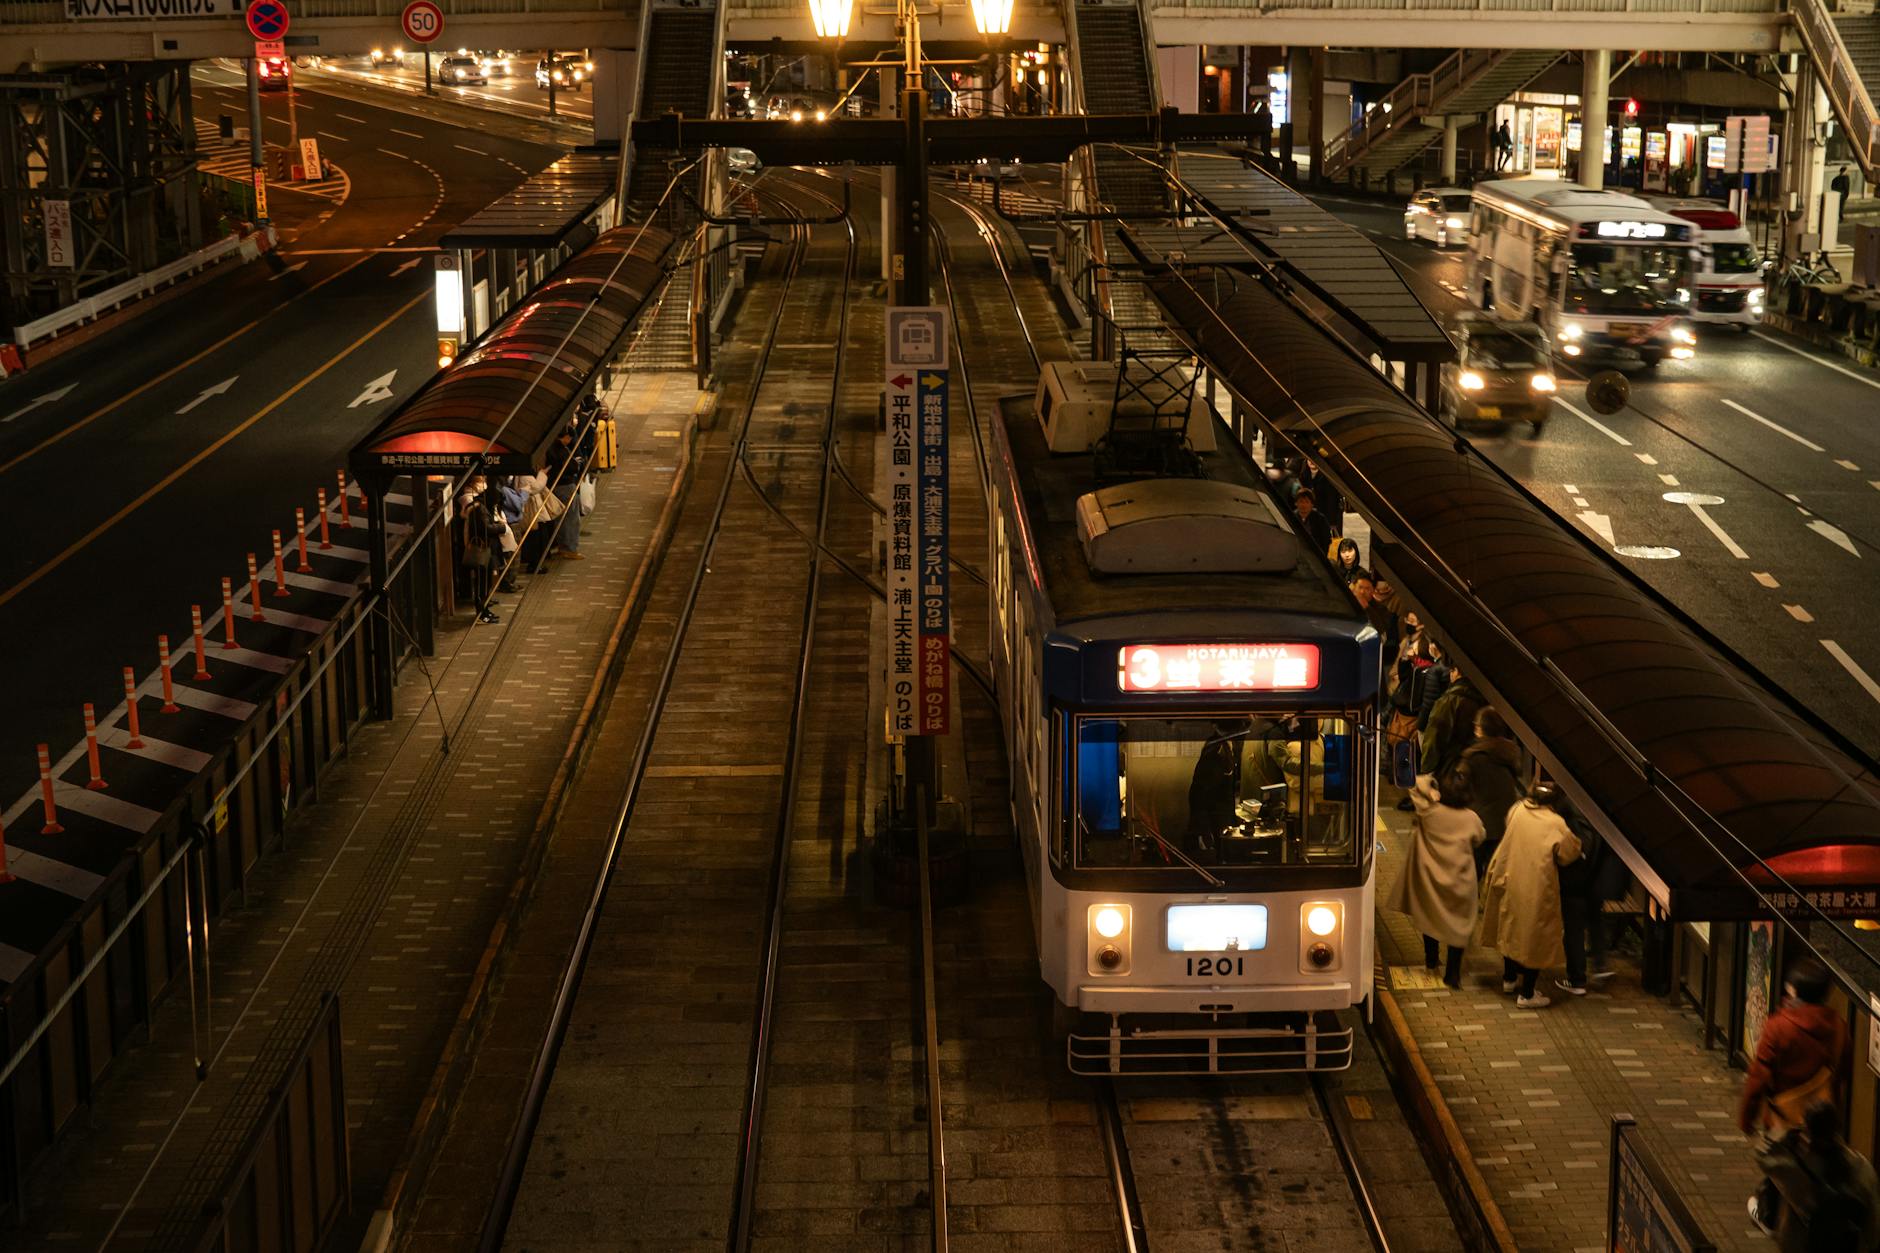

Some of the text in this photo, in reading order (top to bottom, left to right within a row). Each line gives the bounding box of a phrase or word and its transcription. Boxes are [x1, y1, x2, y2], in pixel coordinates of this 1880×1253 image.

[412, 13, 434, 30] 50
[48, 203, 63, 262] バス進入口
[892, 395, 913, 730] 平和公園・原爆資料館・浦上天主堂 のりば
[1130, 648, 1161, 688] 3
[1187, 647, 1288, 661] HOTARUJAYA
[924, 637, 944, 730] めがね橋 のりば
[1187, 957, 1244, 977] 1201
